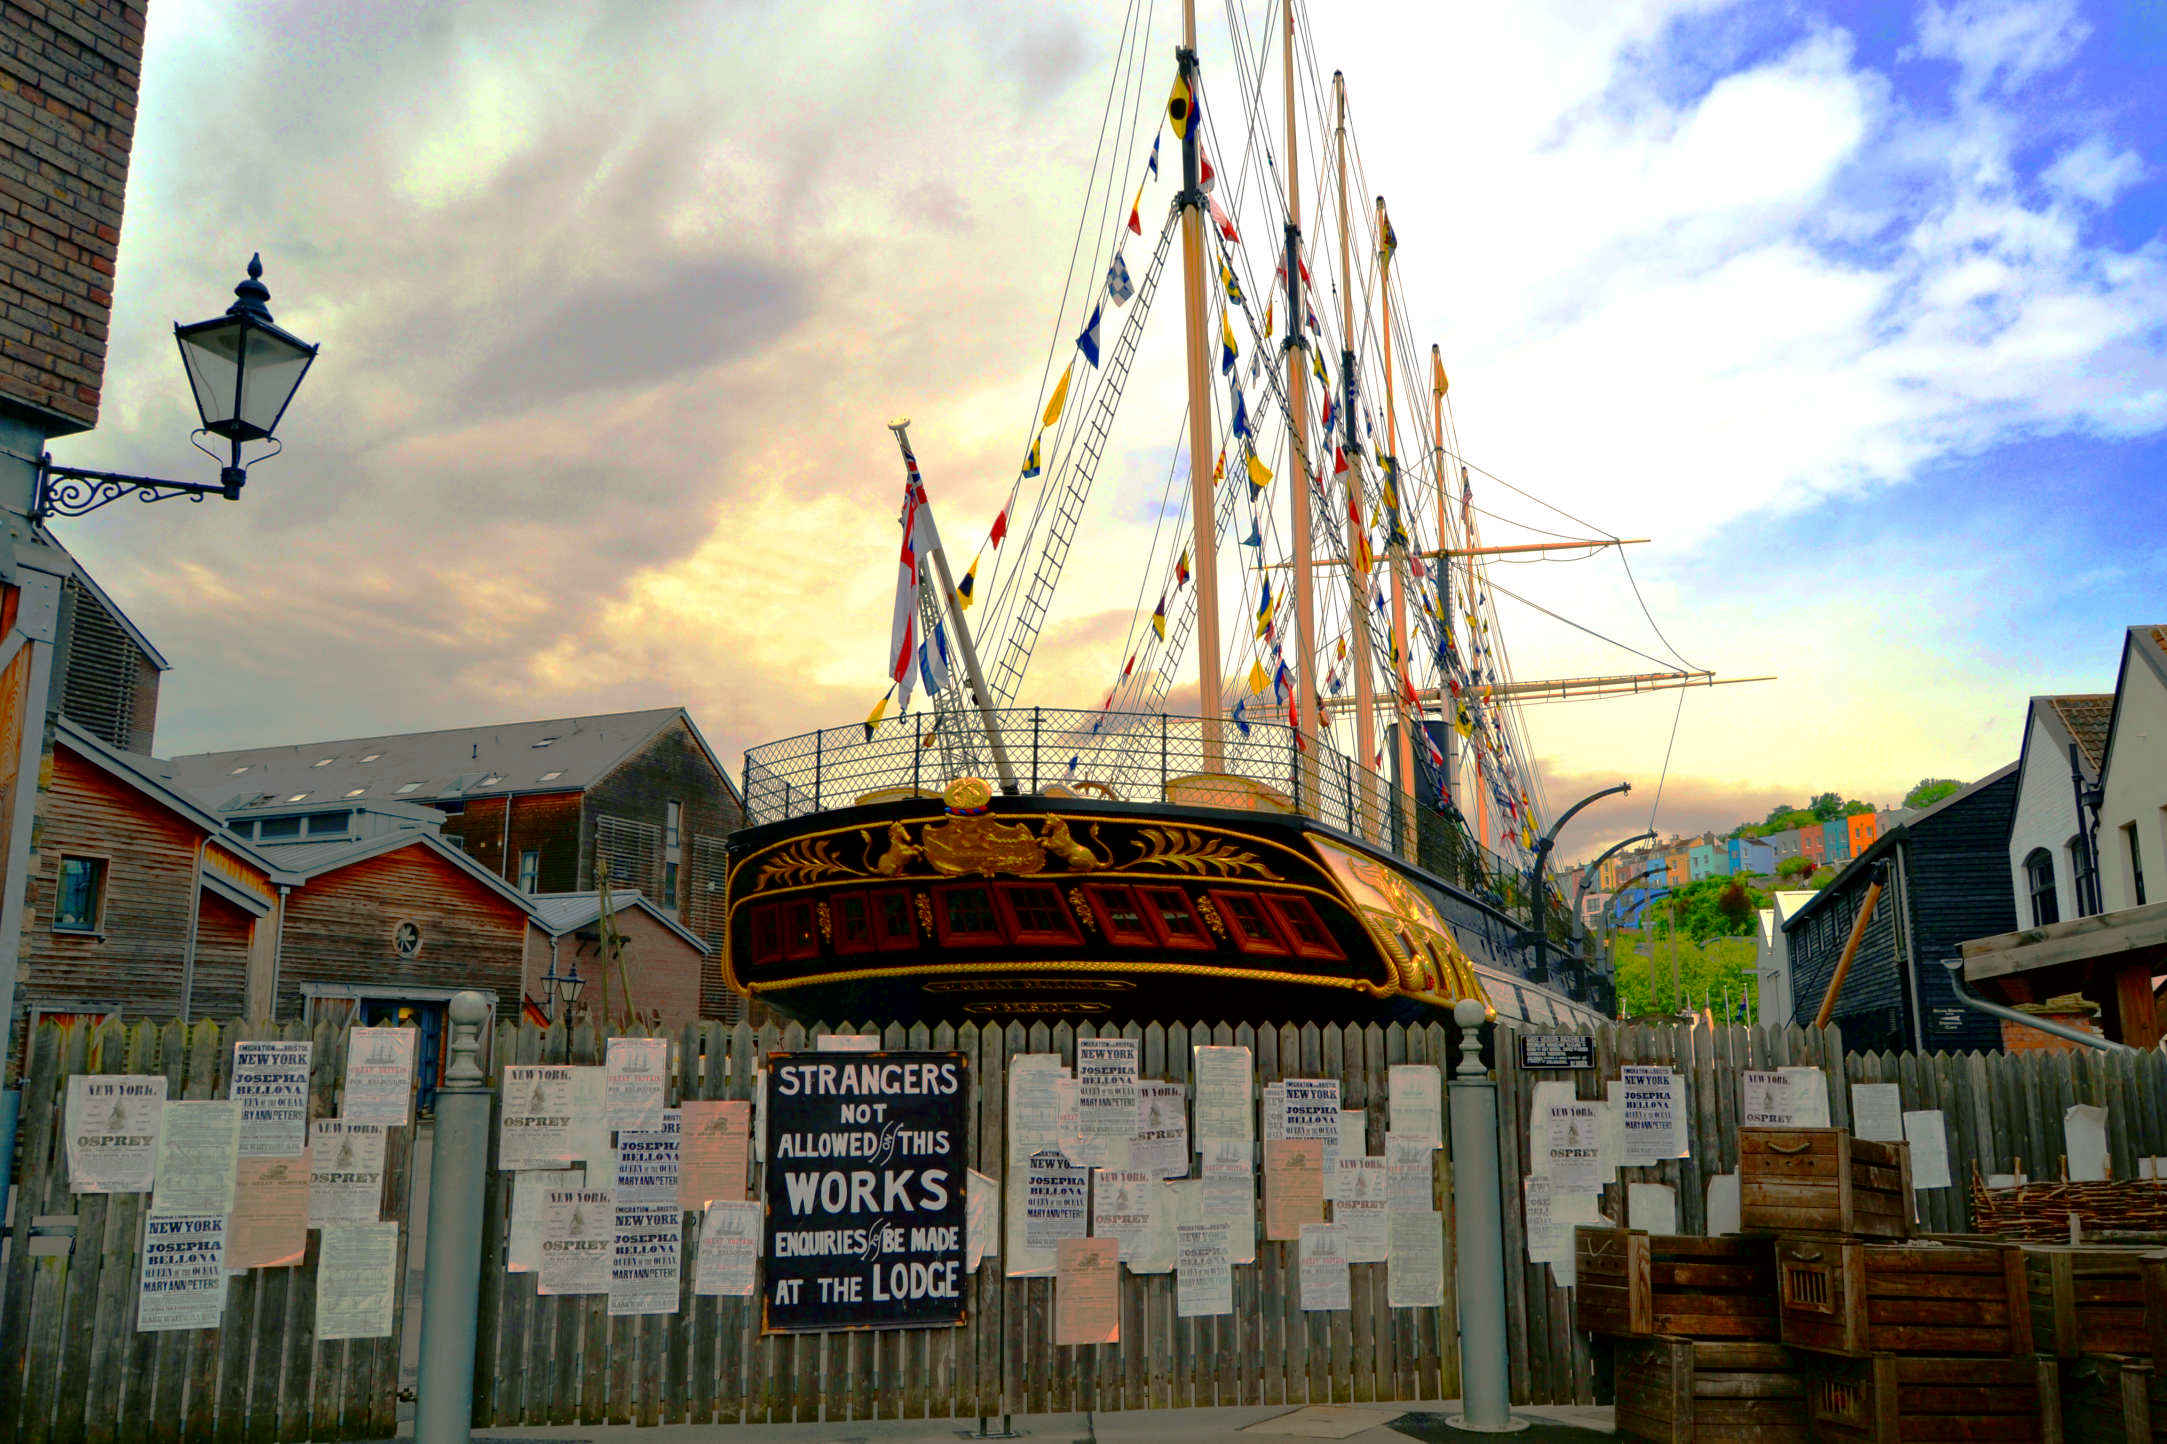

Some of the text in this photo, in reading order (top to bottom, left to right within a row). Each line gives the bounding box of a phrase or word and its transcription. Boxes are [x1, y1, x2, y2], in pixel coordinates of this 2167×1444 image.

[1081, 1050, 1134, 1058] NEW YORK
[238, 1054, 308, 1065] NEW YORK
[235, 1074, 306, 1083] JOSEPHA
[779, 1063, 958, 1096] STRANGERS
[1082, 1076, 1132, 1084] BELLONA
[1624, 1076, 1670, 1085] NEW YORK
[236, 1086, 303, 1094] BELLONA
[1286, 1090, 1336, 1099] NEW YORK
[1624, 1092, 1671, 1100] JOSEPHA
[841, 1104, 887, 1124] NOT
[1286, 1106, 1338, 1114] JOSEPHA
[504, 1117, 570, 1128] OSPREY
[1288, 1116, 1336, 1124] BELLONA
[1747, 1114, 1792, 1122] OSPREY
[1130, 1128, 1184, 1141] SPREY
[77, 1136, 154, 1147] OSPREY
[777, 1132, 877, 1158] ALLOWED
[897, 1130, 950, 1155] THIS
[1550, 1149, 1598, 1158] OSPREY
[1030, 1159, 1070, 1169] NEW YO
[310, 1173, 380, 1184] OSPREY
[1028, 1177, 1085, 1186] JOSEPHA
[785, 1169, 948, 1215] WORKS
[1031, 1187, 1082, 1196] BELLONA
[1337, 1200, 1388, 1208] OSPREY
[1027, 1208, 1046, 1218] MARY
[616, 1214, 678, 1226] NEW YORK
[1096, 1215, 1150, 1224] OSPREY
[149, 1220, 222, 1234] NEW YORK
[616, 1234, 679, 1244] JOSEPHA
[776, 1229, 867, 1257] ENQUIRIES
[882, 1227, 905, 1252] BE
[910, 1226, 959, 1252] MADE
[147, 1241, 222, 1253] JOSEPHA
[543, 1240, 609, 1251] OSPREY
[616, 1245, 674, 1254] BELLONA
[149, 1254, 216, 1265] BELLONA
[612, 1270, 632, 1279] MARY
[144, 1282, 168, 1292] MARY
[776, 1261, 959, 1305] AT THE LODGE
